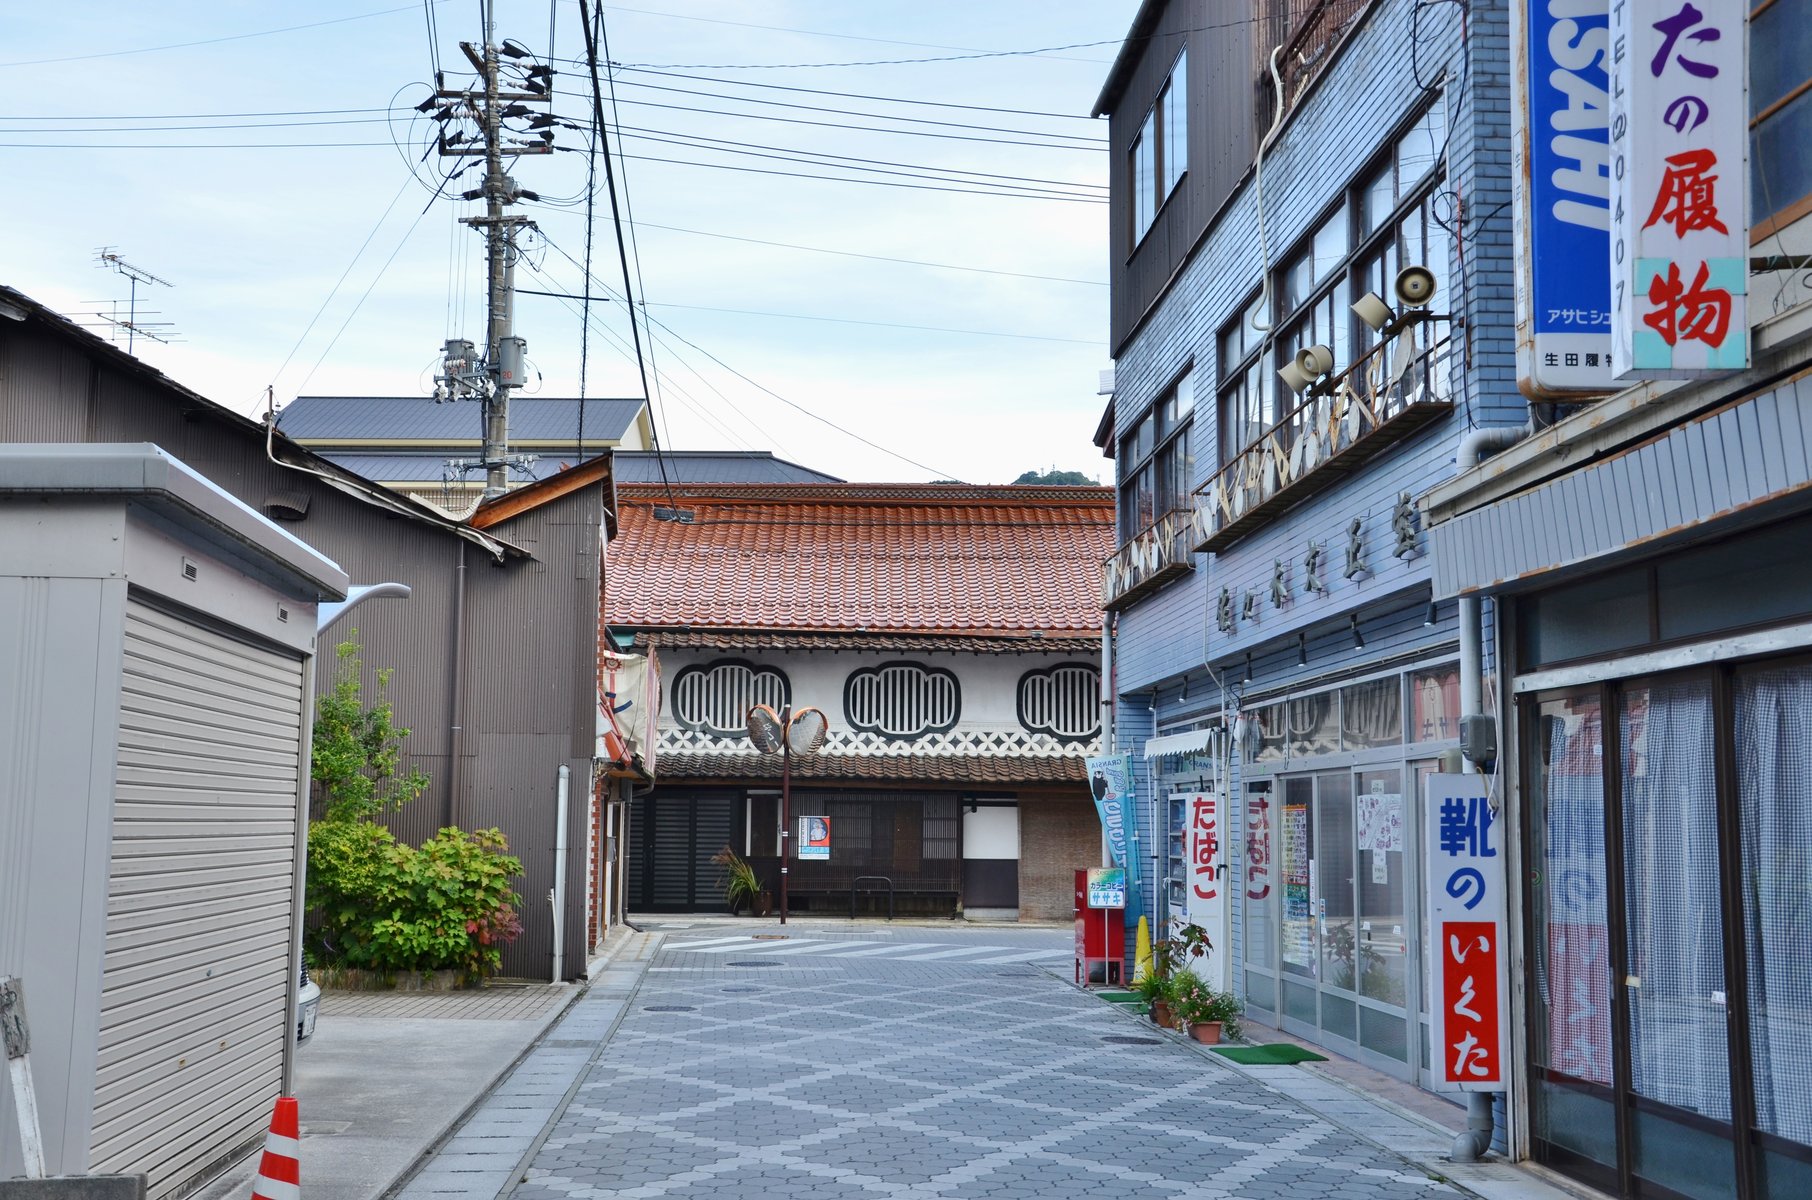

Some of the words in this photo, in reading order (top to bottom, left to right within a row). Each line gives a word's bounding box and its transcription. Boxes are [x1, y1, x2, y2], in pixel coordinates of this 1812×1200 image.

[1548, 0, 1609, 231] SAHI
[1092, 892, 1121, 905] ササキ
[1193, 797, 1217, 899] たばこ
